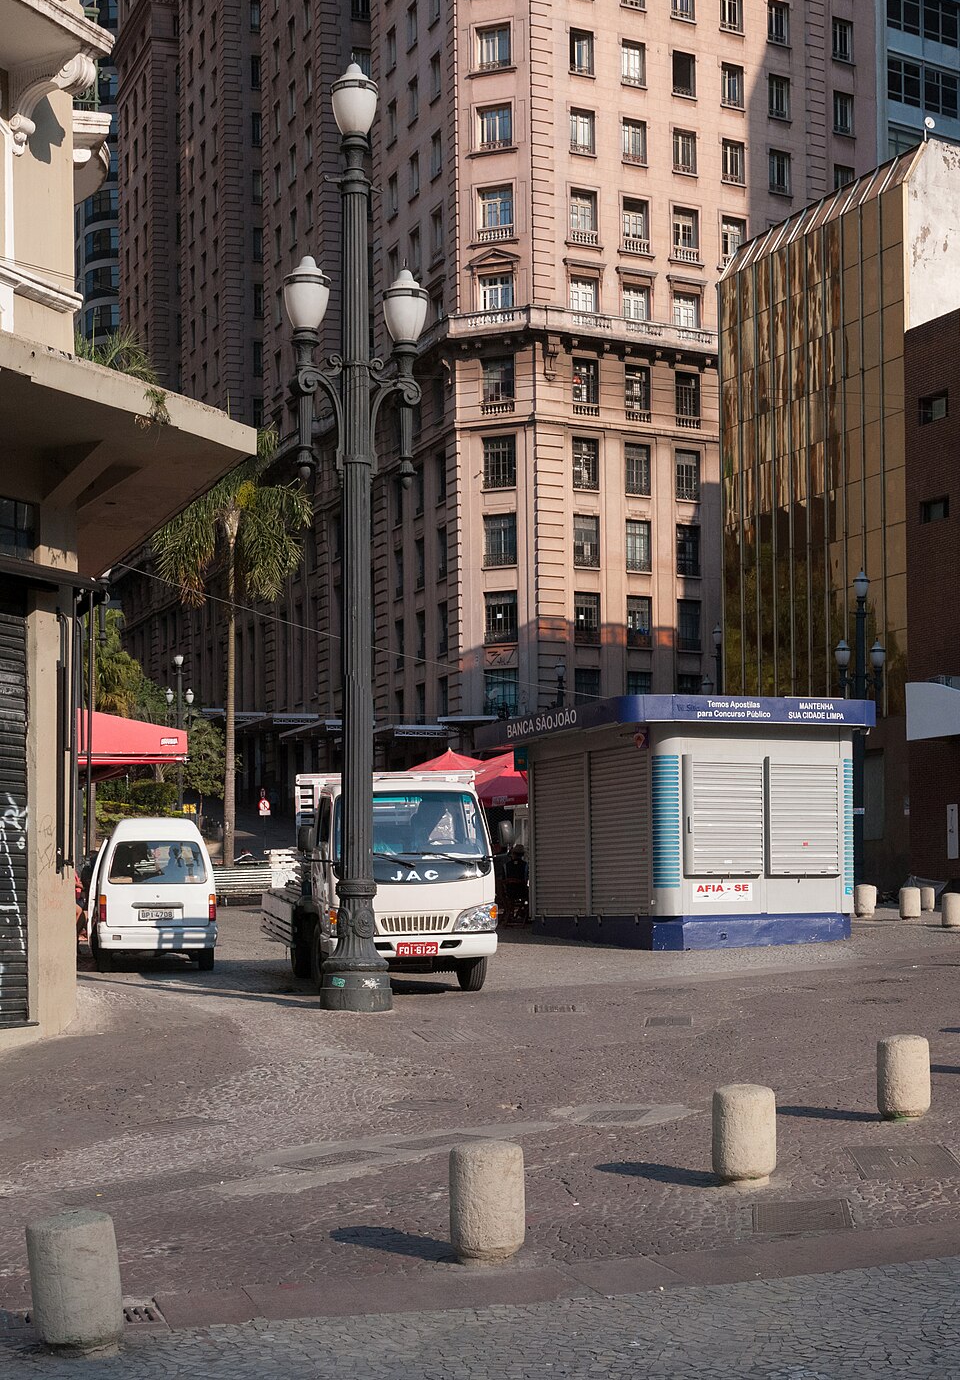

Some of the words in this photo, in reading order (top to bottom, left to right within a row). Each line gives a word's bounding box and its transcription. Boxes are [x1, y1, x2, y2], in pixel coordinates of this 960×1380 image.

[707, 700, 729, 708] Temos
[730, 700, 760, 709] Apostilas
[799, 702, 834, 710] MANTENHA
[713, 710, 746, 718] Concurso
[746, 710, 771, 718] Público
[788, 711, 802, 719] SUA
[826, 712, 845, 720] LIMPA
[506, 719, 535, 738] BANCA
[390, 869, 439, 881] JAC
[696, 884, 724, 893] AFIA
[734, 884, 749, 892] SE
